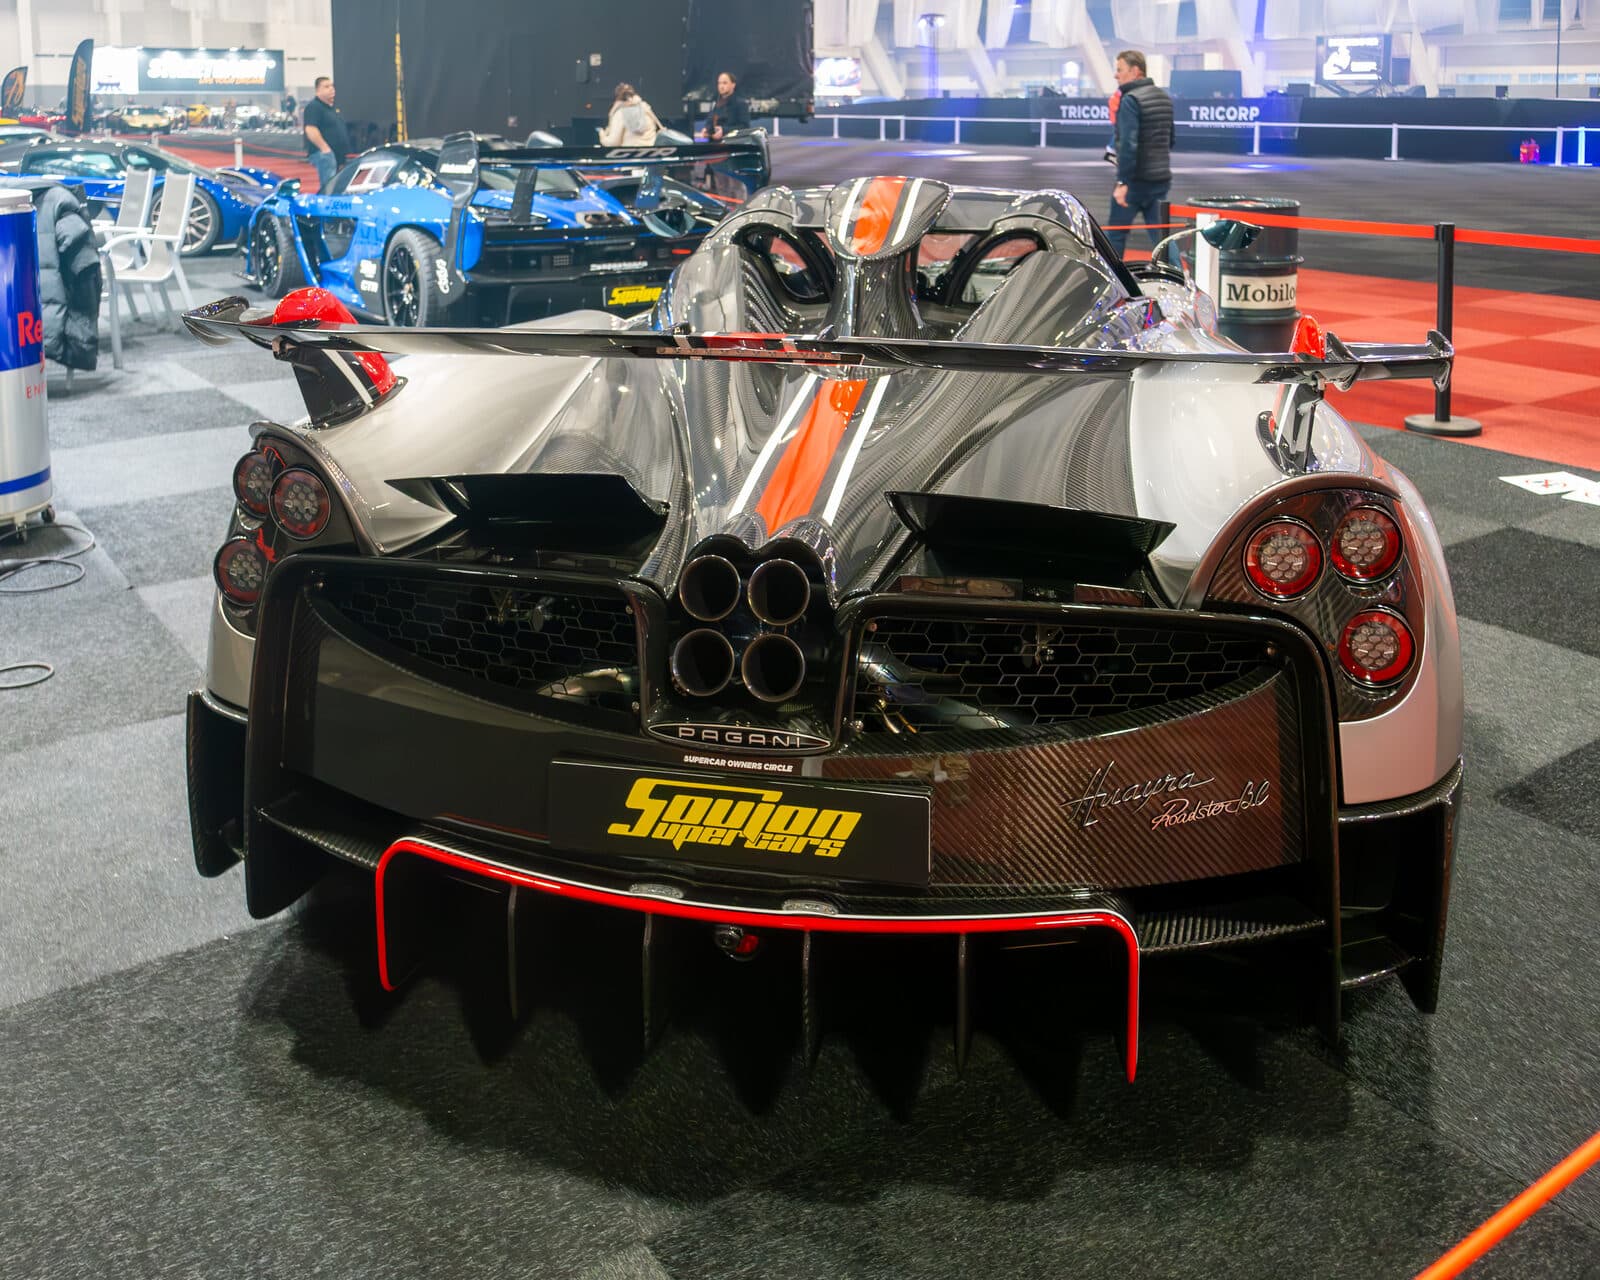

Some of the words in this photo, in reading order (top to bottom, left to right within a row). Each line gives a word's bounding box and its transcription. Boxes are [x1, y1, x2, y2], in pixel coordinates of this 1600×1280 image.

[1060, 105, 1109, 119] TRICOR
[1189, 106, 1260, 120] TRICORP
[678, 727, 800, 748] PAGANI
[684, 755, 726, 767] SUPERCAR
[727, 758, 763, 770] OWNERS
[763, 761, 793, 772] CIRCLE
[1060, 760, 1215, 827] Huayra
[1151, 798, 1238, 831] Roadster
